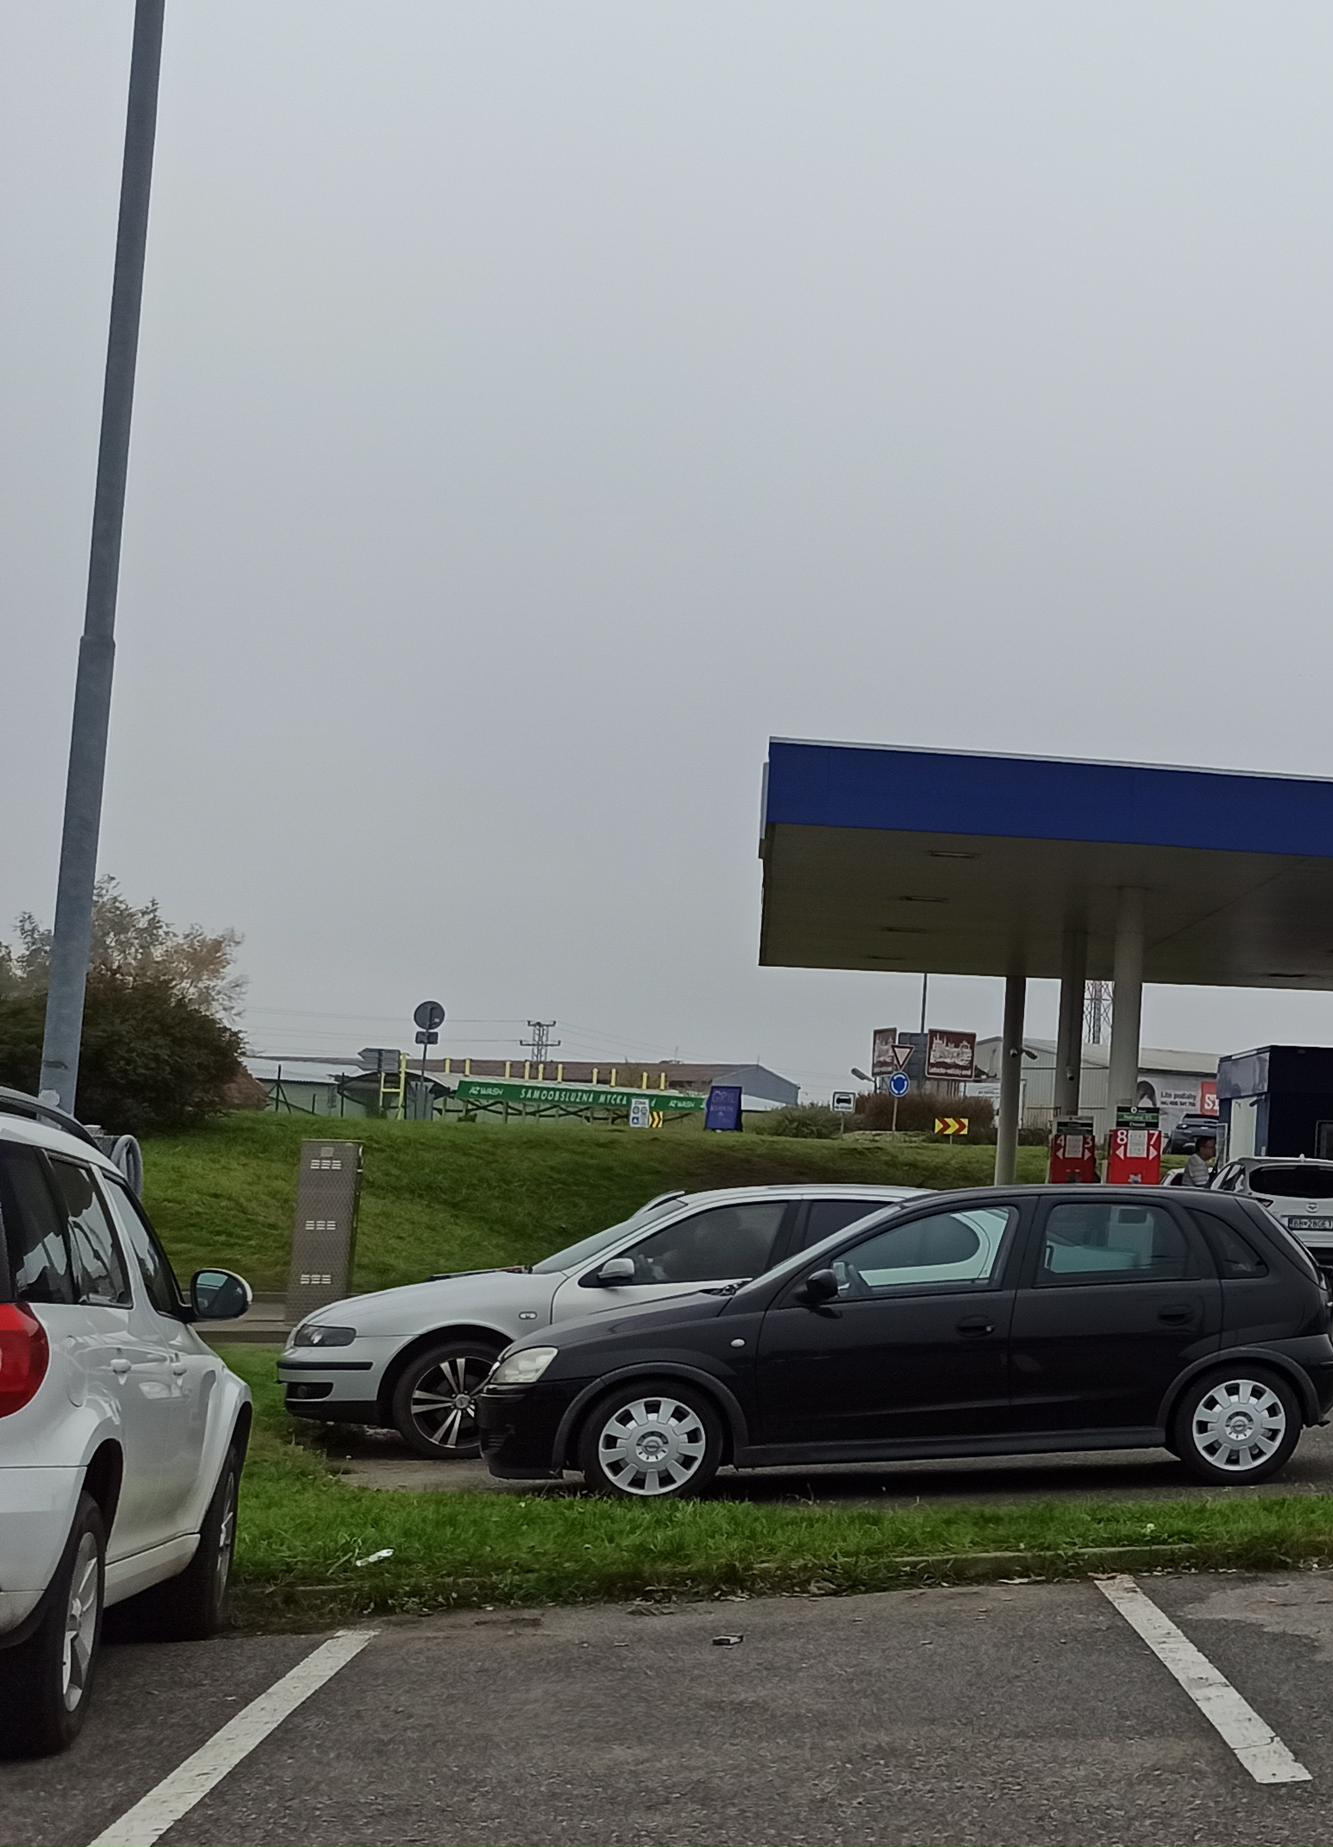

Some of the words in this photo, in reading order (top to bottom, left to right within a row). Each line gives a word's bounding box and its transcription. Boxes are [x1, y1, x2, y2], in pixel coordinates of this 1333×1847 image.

[1056, 1135, 1065, 1147] 4
[1116, 1130, 1127, 1144] 8
[1149, 1130, 1159, 1145] 7
